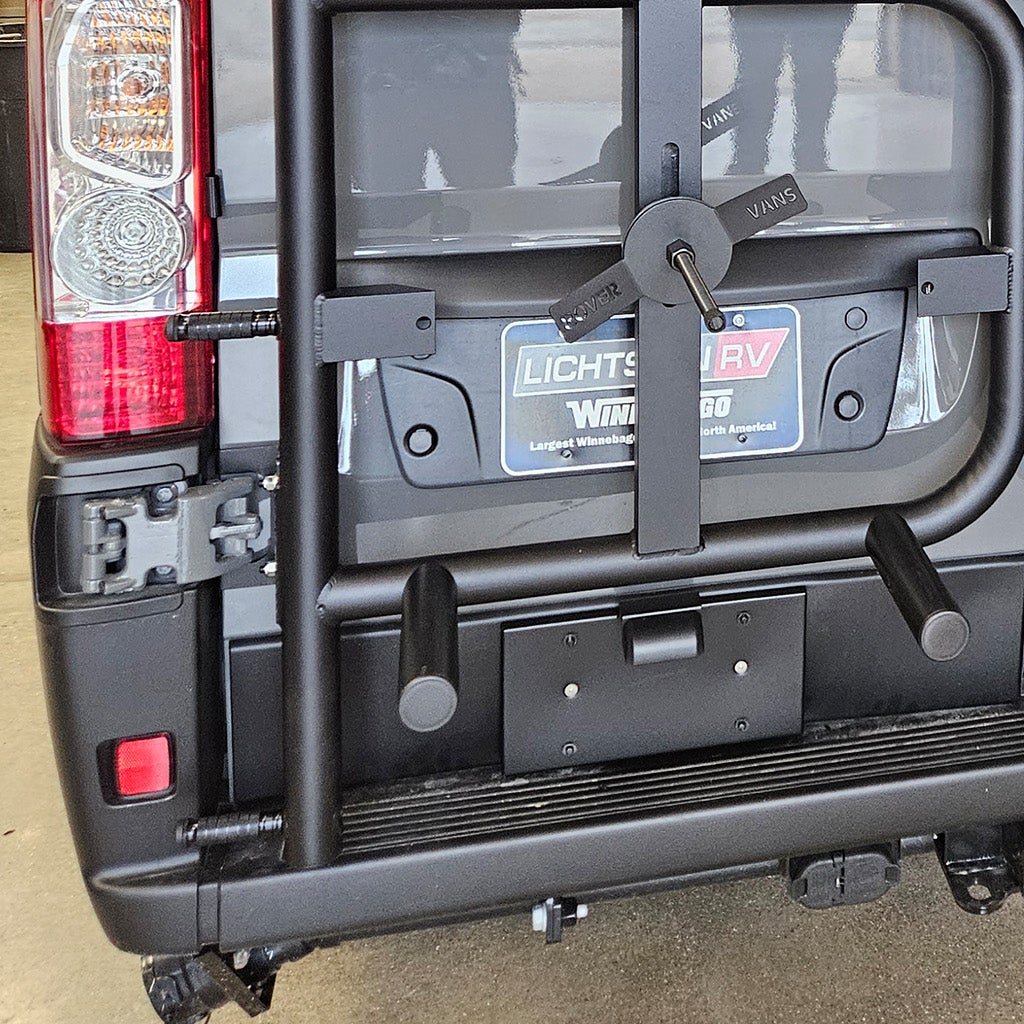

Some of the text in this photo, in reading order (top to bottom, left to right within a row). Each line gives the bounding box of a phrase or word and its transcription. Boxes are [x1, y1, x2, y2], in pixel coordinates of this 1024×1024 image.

[745, 187, 798, 220] VANS
[560, 283, 623, 331] ROVER
[720, 342, 772, 370] RV
[529, 436, 575, 452] Largest
